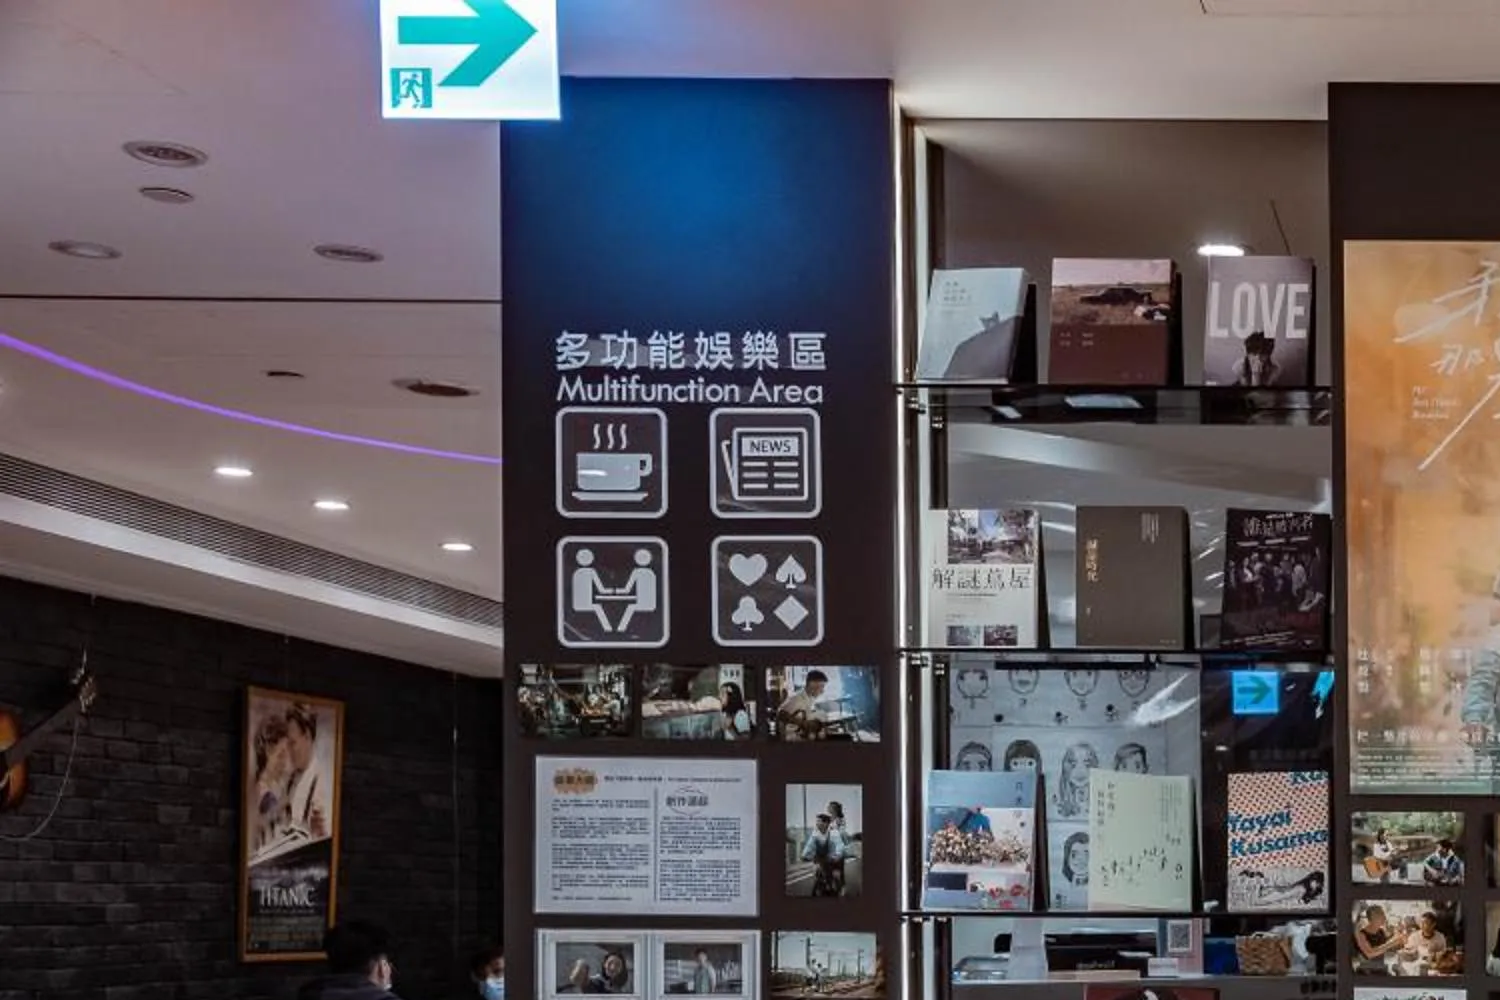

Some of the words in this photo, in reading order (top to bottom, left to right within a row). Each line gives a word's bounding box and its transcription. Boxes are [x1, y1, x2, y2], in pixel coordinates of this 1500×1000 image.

[1209, 281, 1309, 339] LOVE
[556, 330, 826, 371] 多功能娛樂區
[556, 374, 740, 403] Multifunction
[749, 376, 824, 404] Area
[750, 440, 792, 453] NEWS
